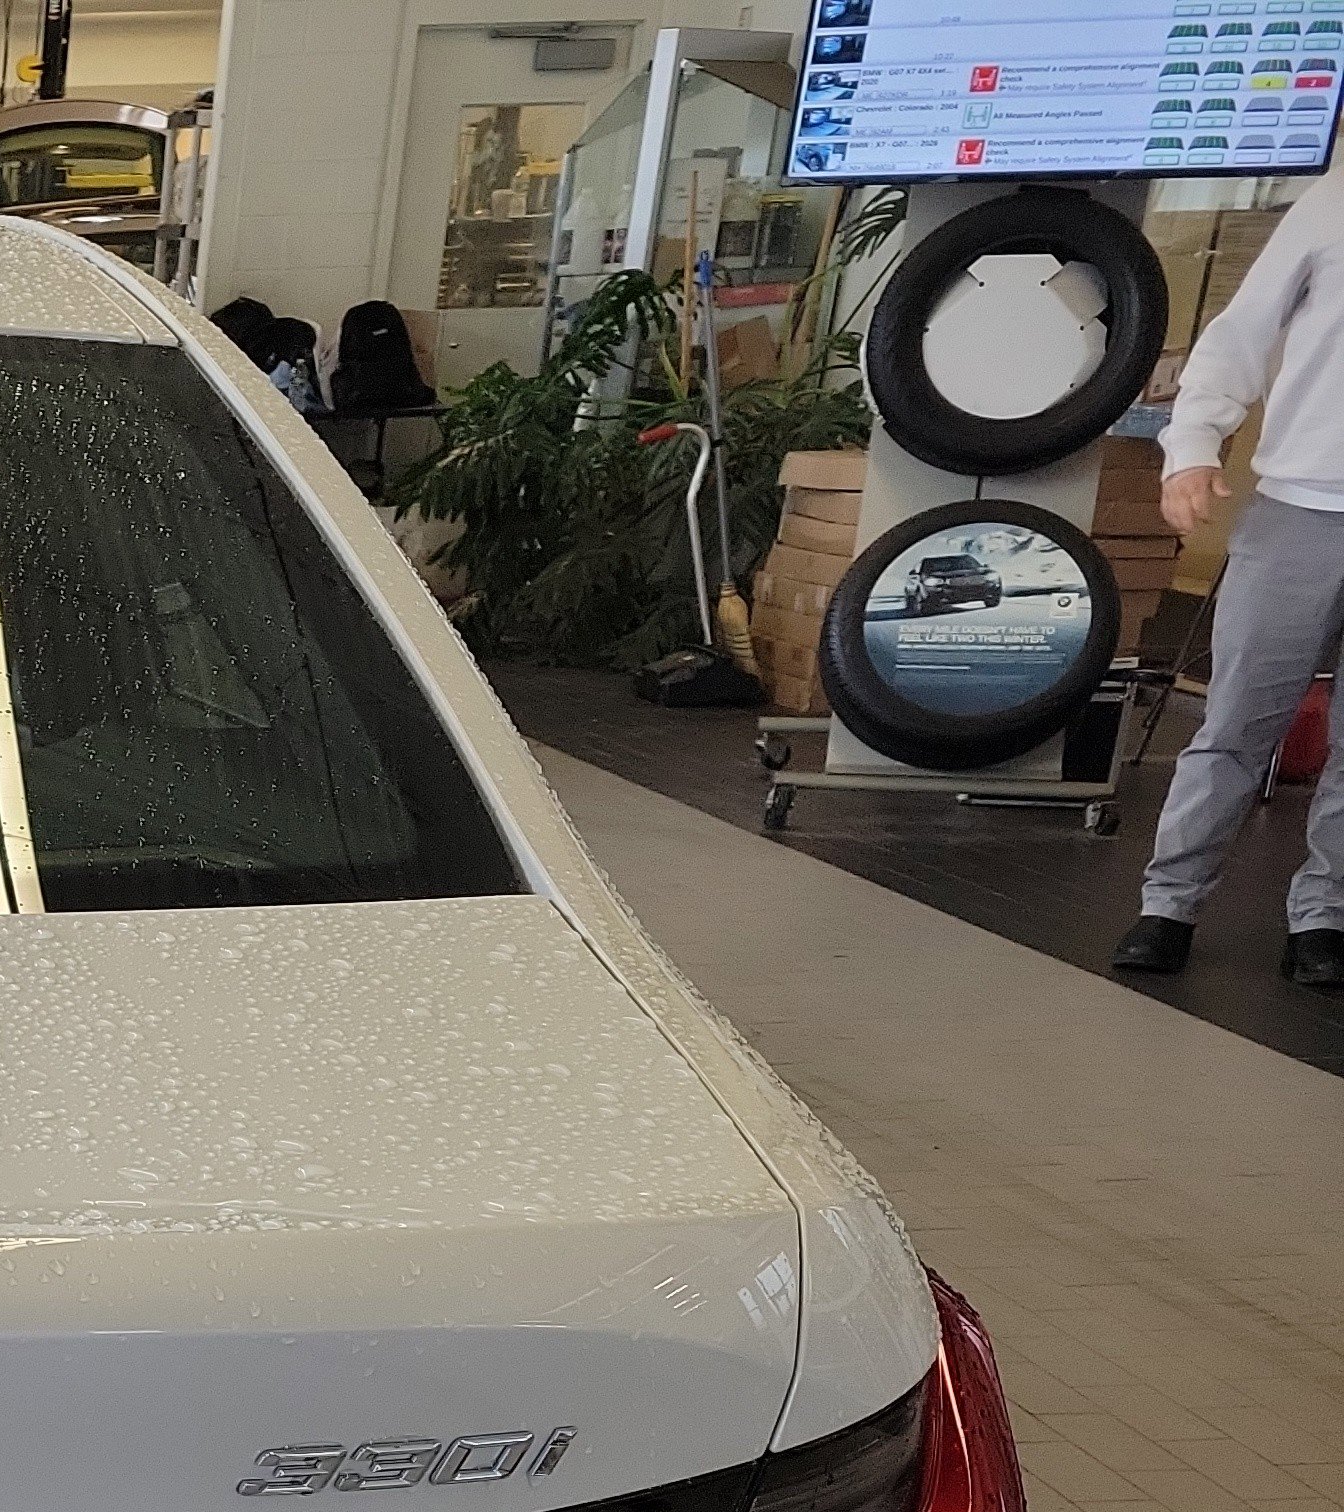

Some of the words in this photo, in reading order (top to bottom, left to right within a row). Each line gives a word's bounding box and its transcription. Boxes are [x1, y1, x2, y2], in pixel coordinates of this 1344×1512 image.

[1001, 65, 1051, 73] Recommend
[1059, 63, 1119, 72] comprehensive
[1120, 62, 1160, 71] alignment
[856, 104, 892, 113] Chevrolet
[898, 103, 934, 112] Colorado
[1005, 111, 1043, 119] Measured
[1044, 110, 1072, 119] Angles
[1073, 110, 1103, 118] Passed
[987, 139, 1036, 147] Recommend
[1044, 137, 1104, 147] comprehensive
[1105, 136, 1145, 145] alignment
[1041, 627, 1055, 635] TO
[899, 634, 923, 643] FEEL
[951, 635, 974, 643] TWO
[977, 635, 1002, 643] THIS
[236, 1425, 578, 1496] 330i
